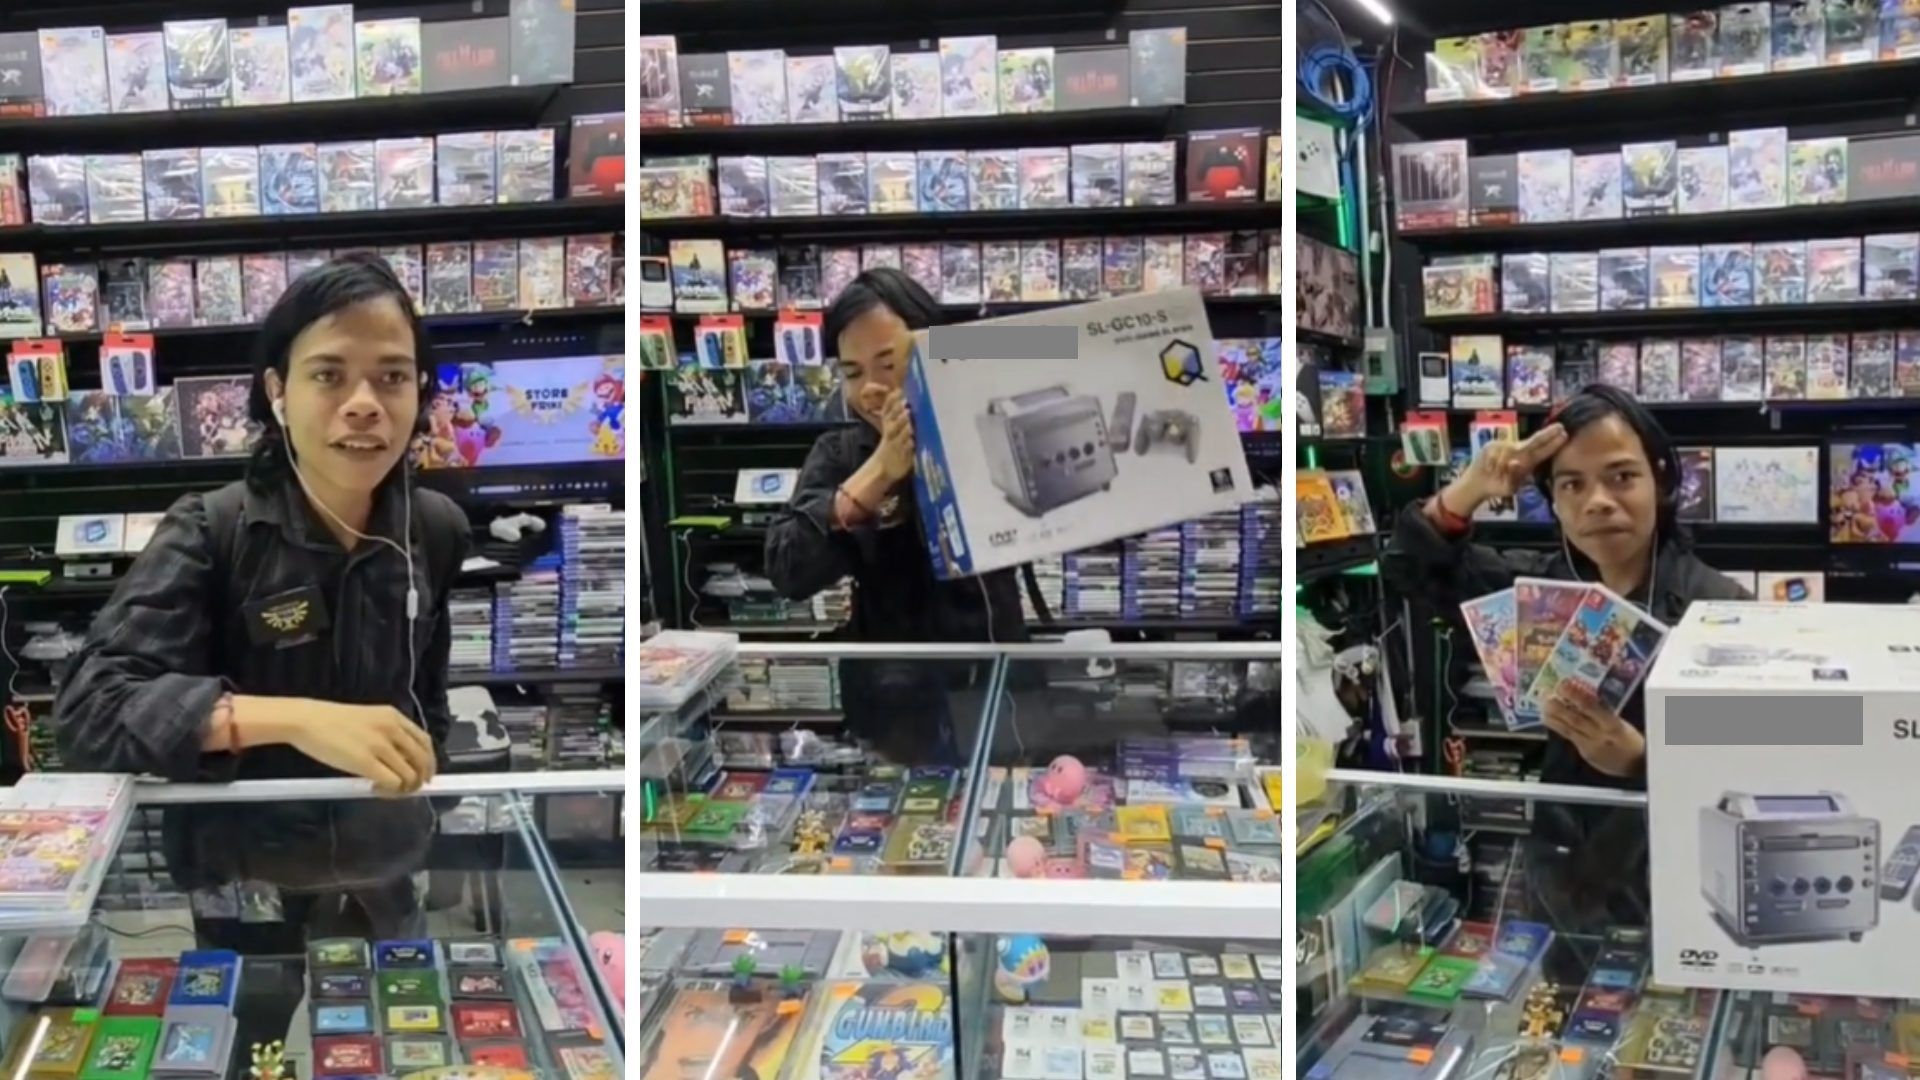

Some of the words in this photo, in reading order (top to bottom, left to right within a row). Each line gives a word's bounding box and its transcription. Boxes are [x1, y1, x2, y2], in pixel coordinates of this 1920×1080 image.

[1086, 309, 1169, 337] SL-GC10-S
[525, 388, 568, 400] STORE
[1680, 949, 1718, 961] DVD
